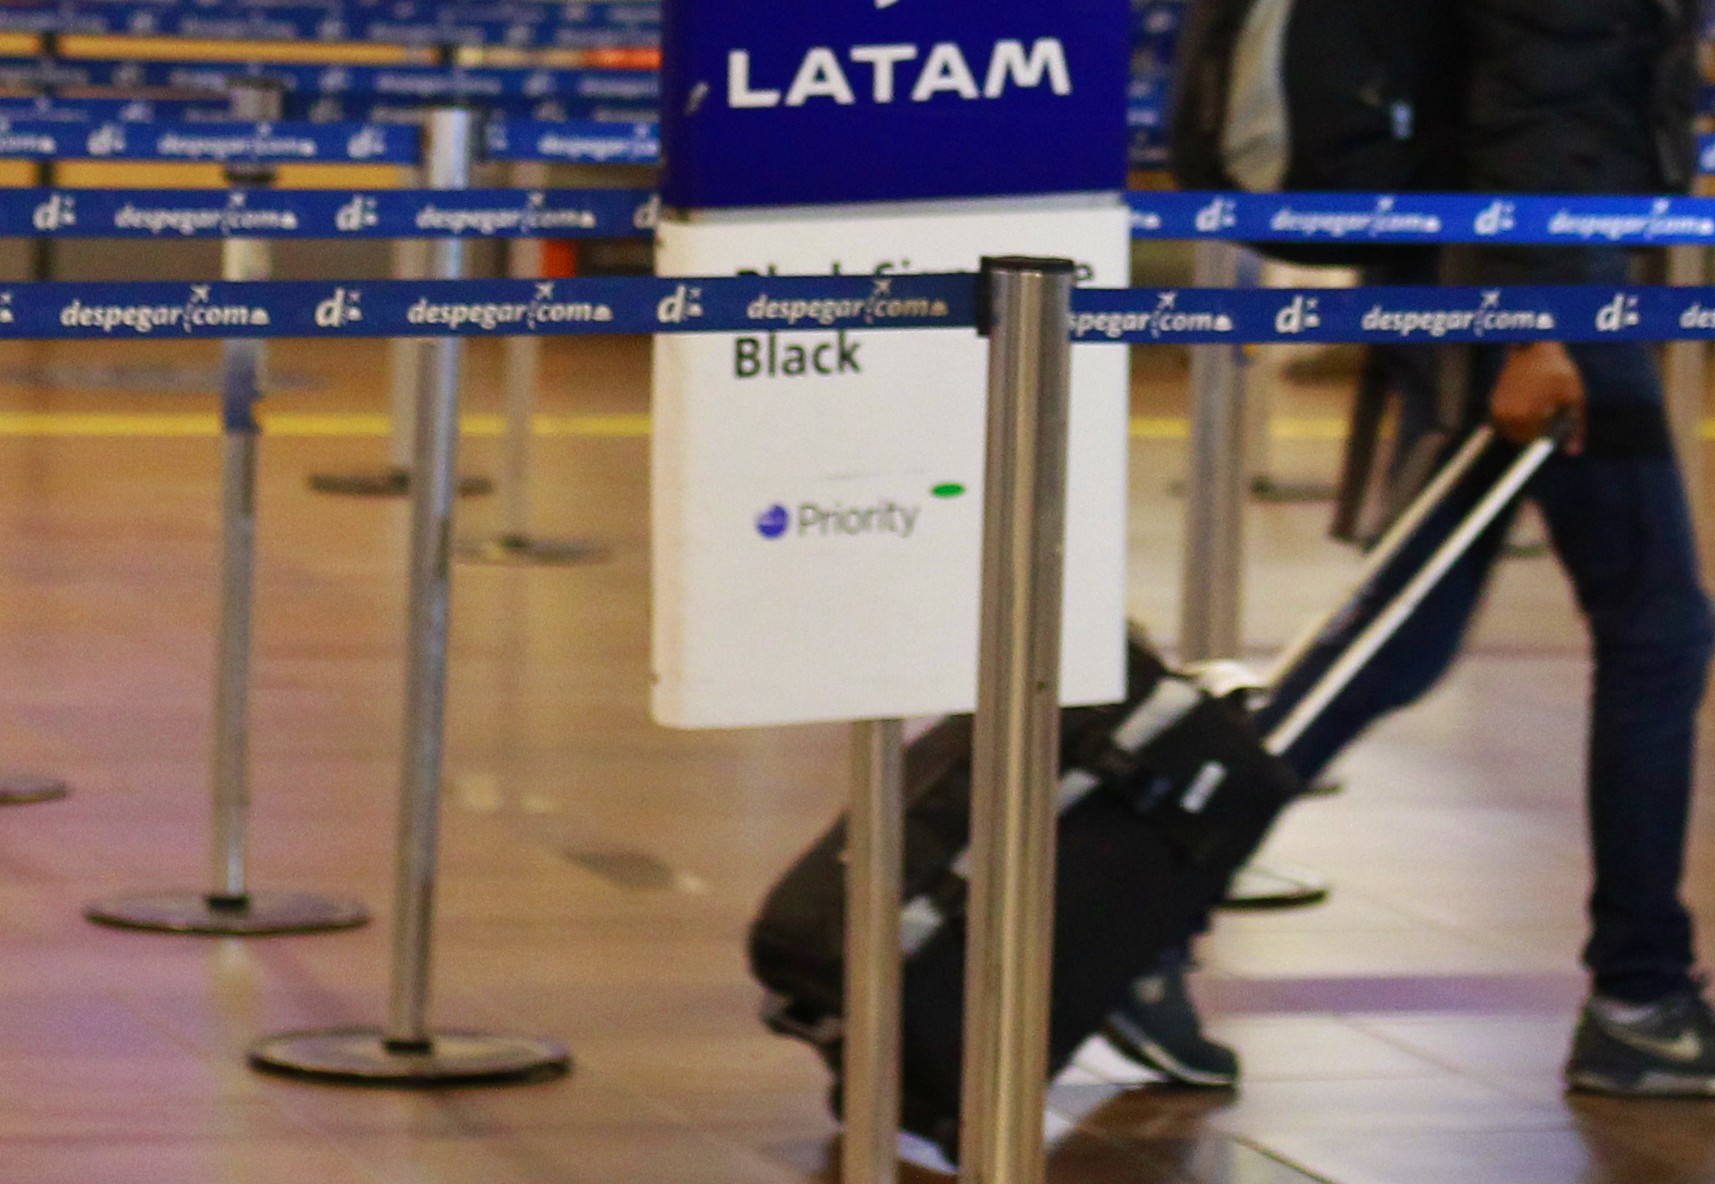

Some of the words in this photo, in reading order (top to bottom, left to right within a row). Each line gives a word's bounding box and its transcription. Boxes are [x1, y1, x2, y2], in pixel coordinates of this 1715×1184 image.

[728, 37, 1072, 109] LATAM
[735, 330, 861, 378] Black
[797, 500, 920, 538] Priority
